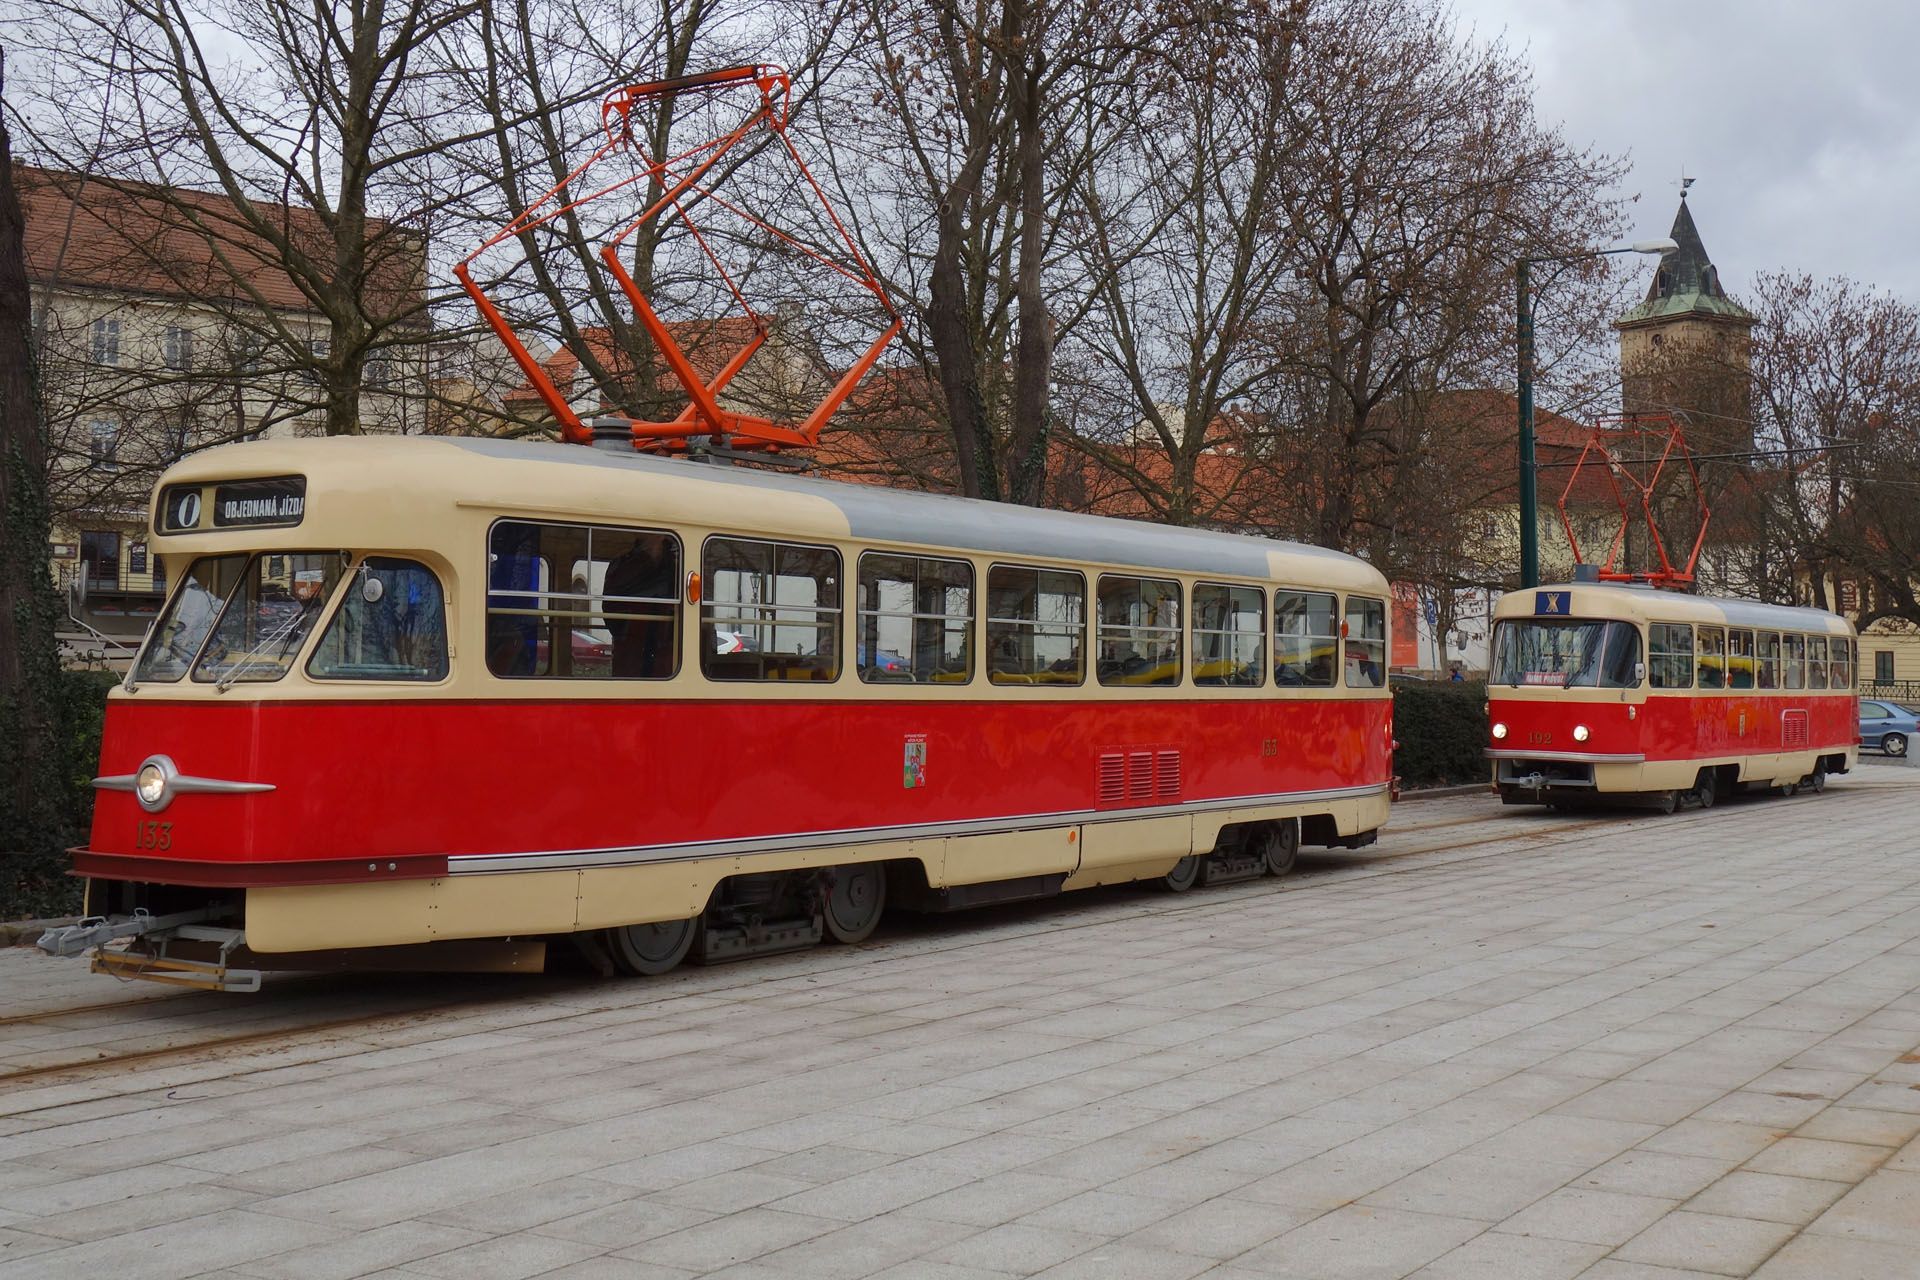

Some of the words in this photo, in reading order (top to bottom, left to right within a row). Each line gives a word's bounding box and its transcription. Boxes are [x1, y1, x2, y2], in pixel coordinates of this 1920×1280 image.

[225, 496, 277, 518] OBJEDNANÁ
[1545, 593, 1560, 612] X
[1262, 738, 1277, 756] 133
[1529, 731, 1552, 745] 192
[138, 820, 173, 850] 133
